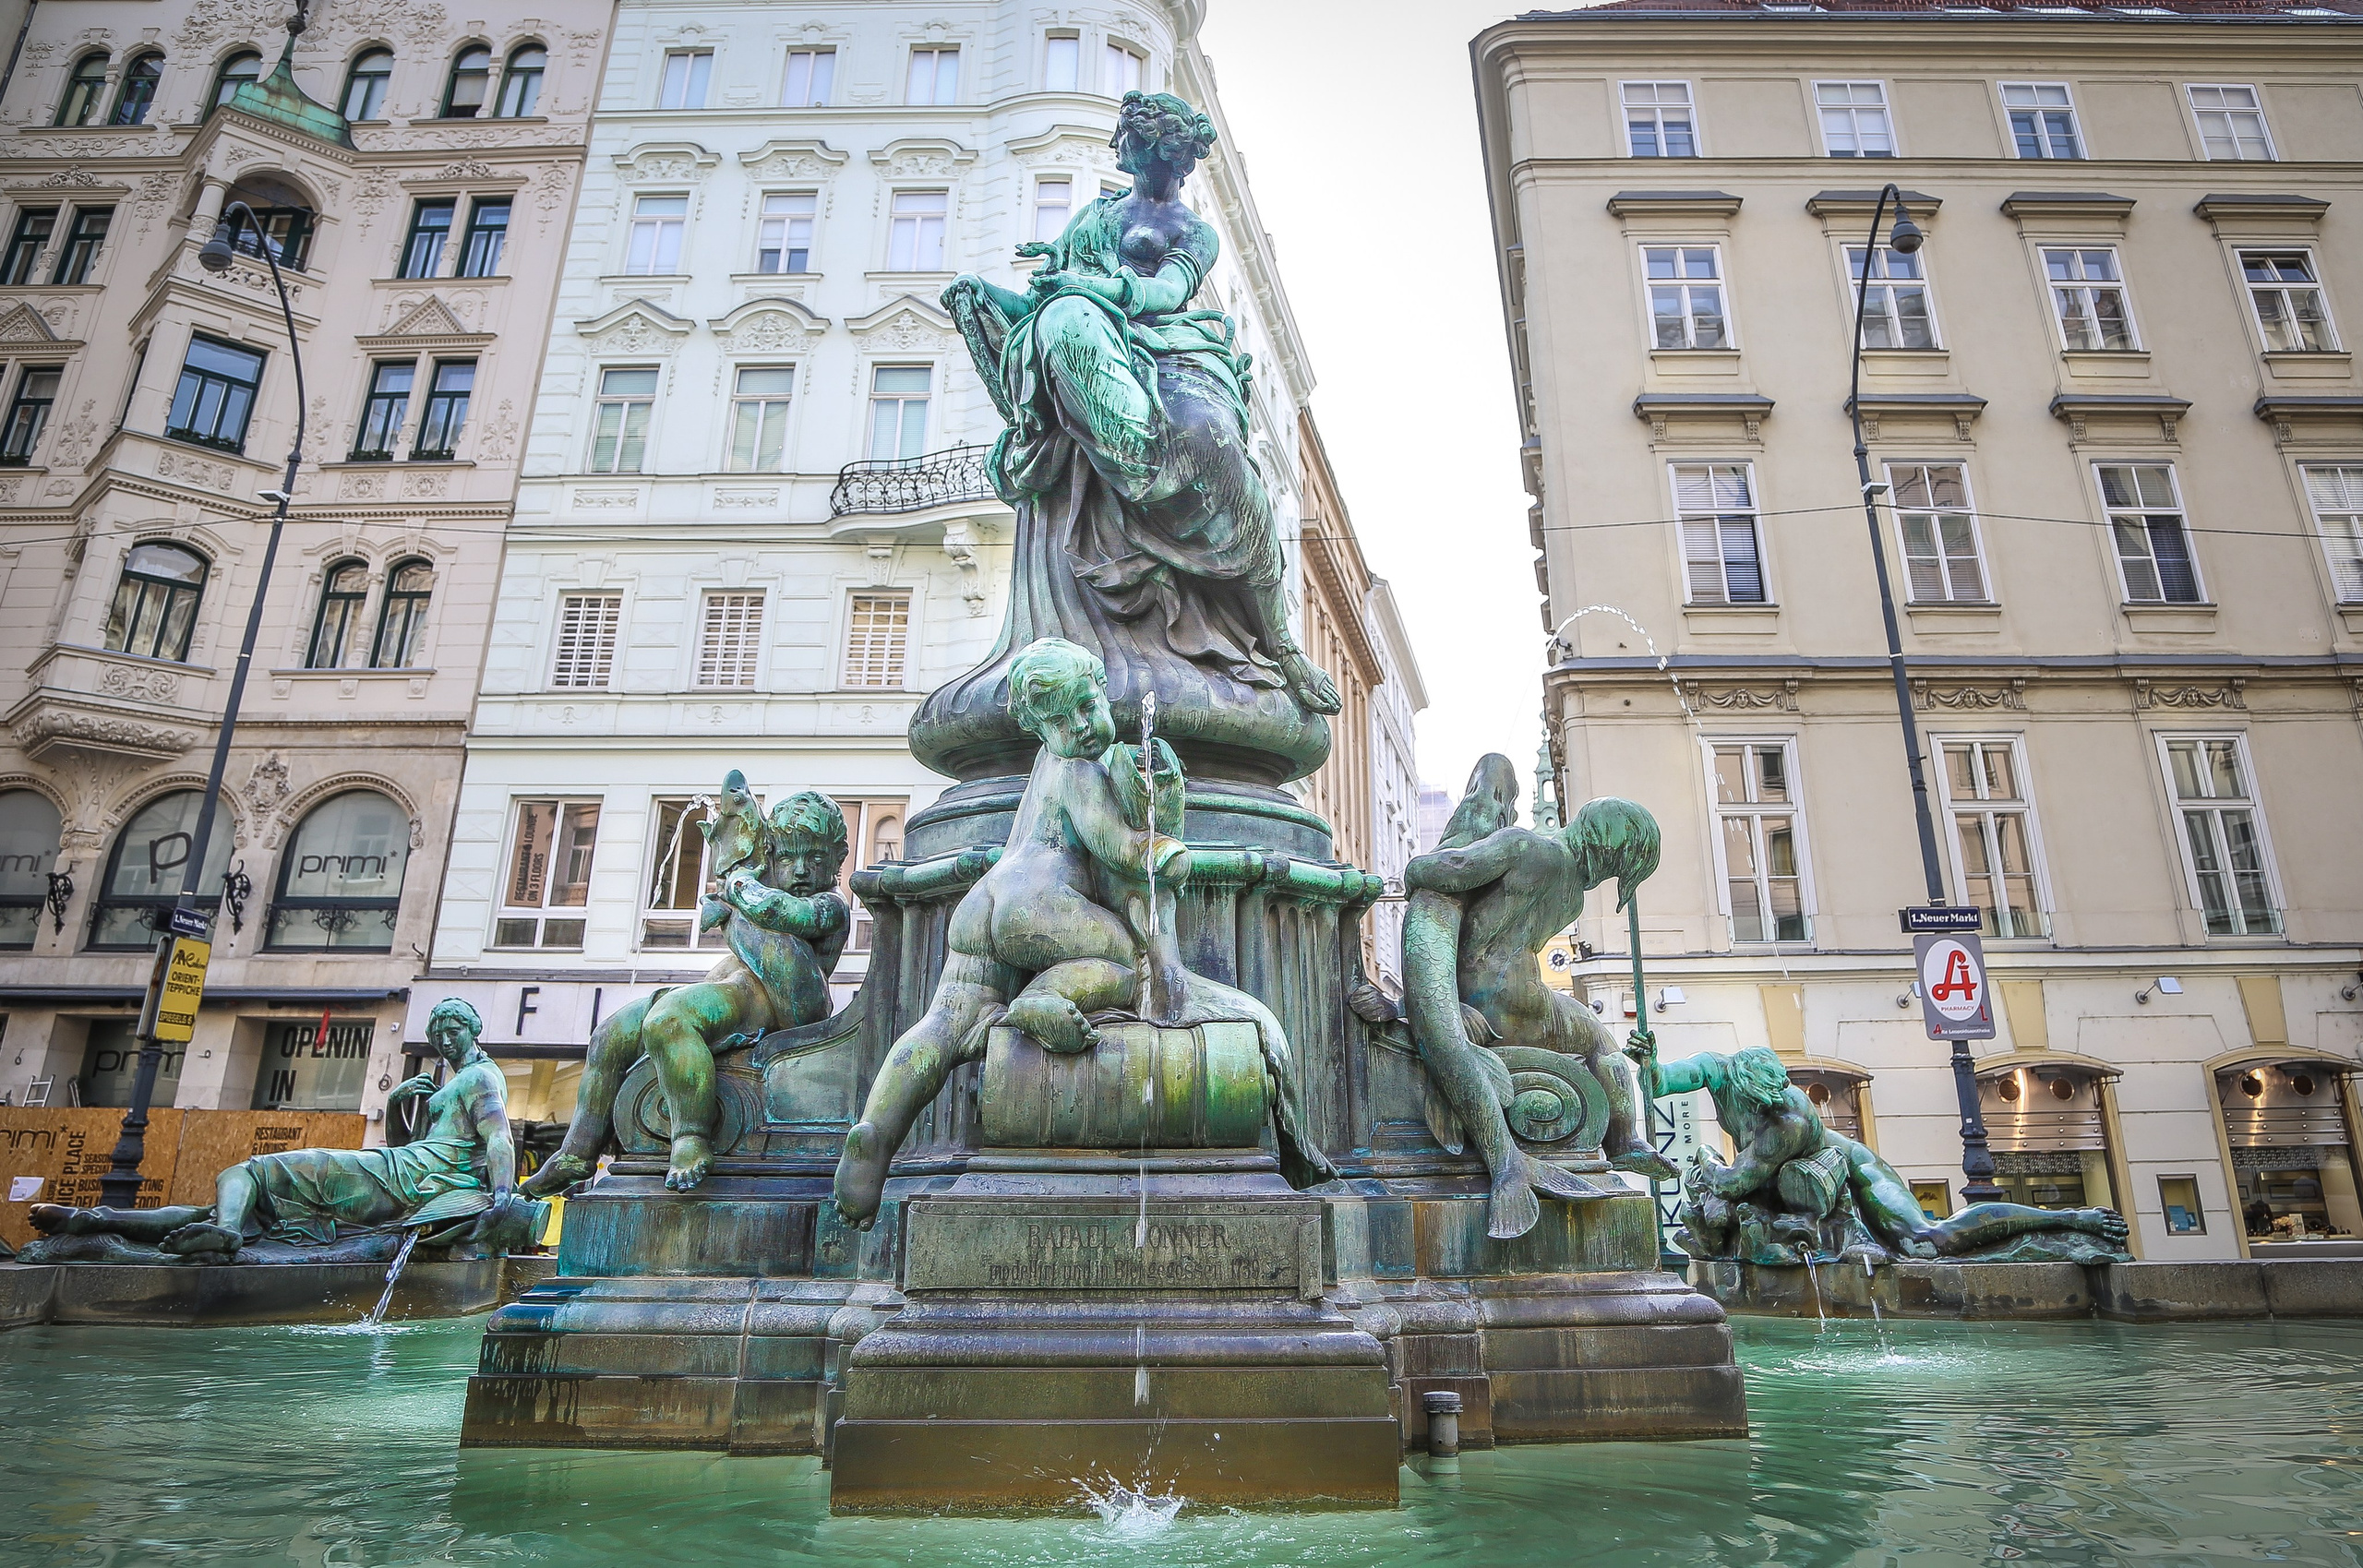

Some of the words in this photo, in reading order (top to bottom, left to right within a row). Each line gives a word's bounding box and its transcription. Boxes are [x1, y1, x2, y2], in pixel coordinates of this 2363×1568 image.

[1950, 913, 1978, 922] Markt
[167, 982, 201, 997] TEPPICHE
[269, 1070, 296, 1102] IN
[1682, 1100, 1693, 1144] MORE
[63, 1131, 87, 1175] PLACE
[1026, 1225, 1115, 1248] RAFAEL
[1063, 1259, 1091, 1281] und
